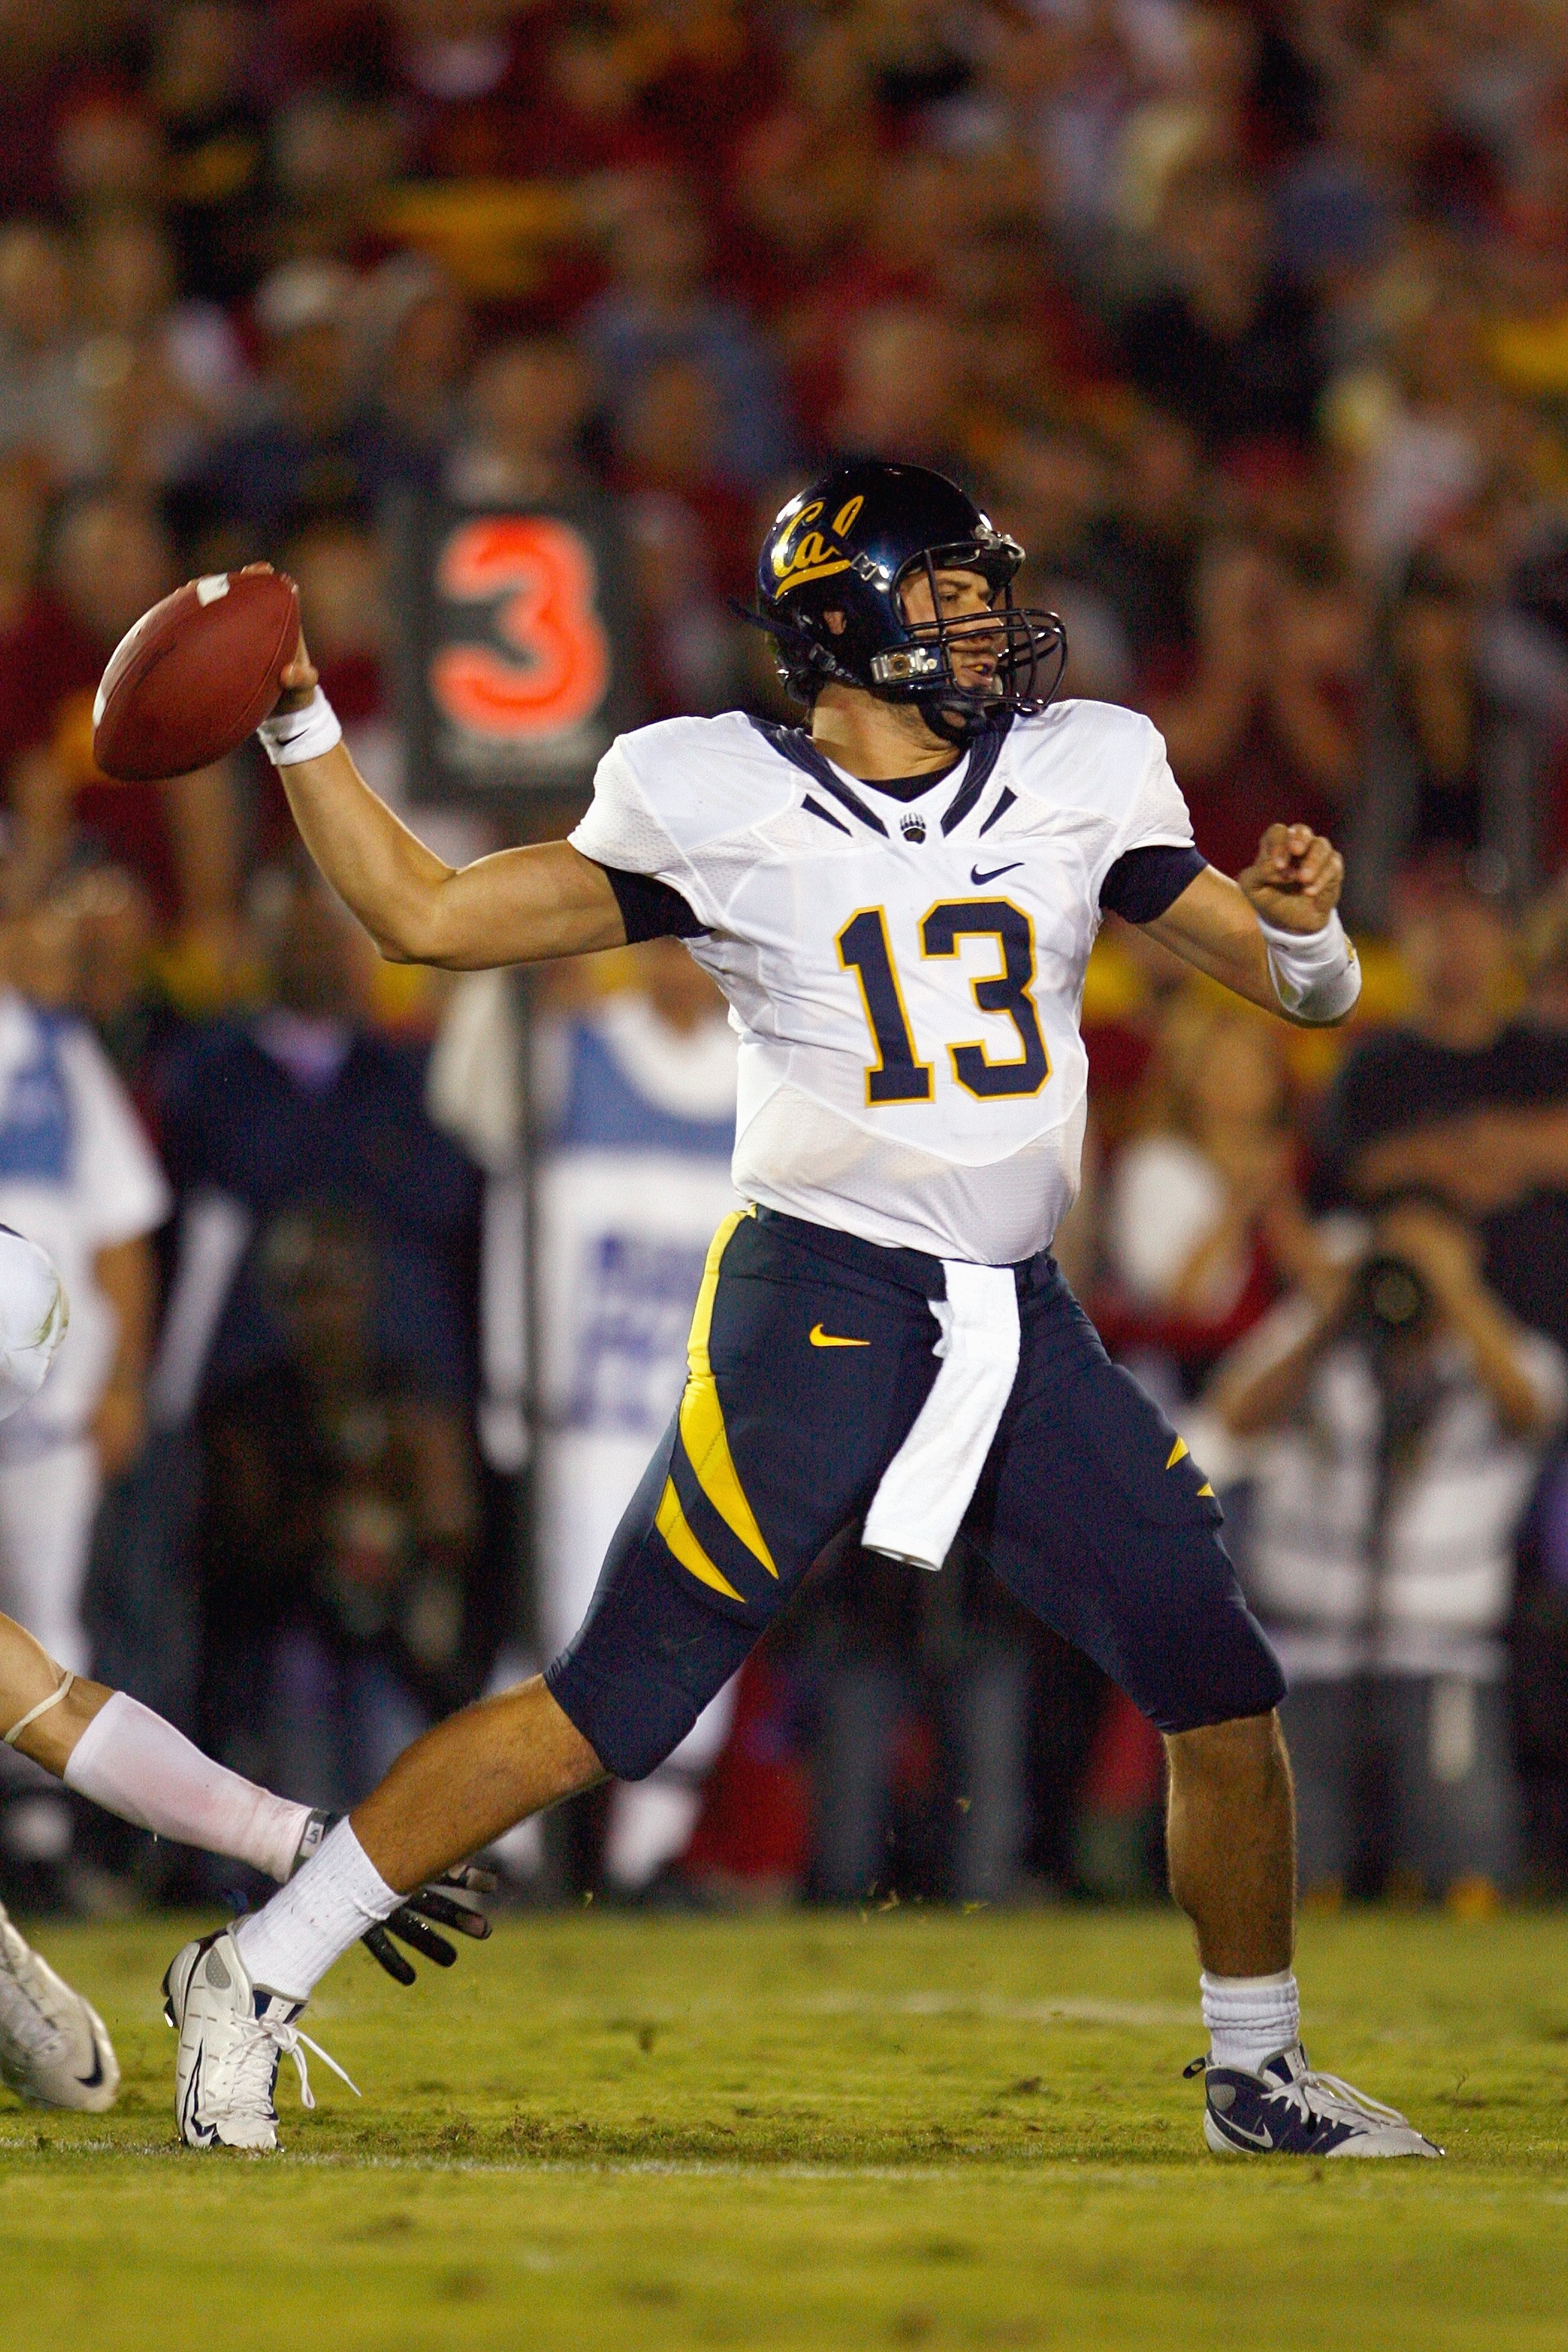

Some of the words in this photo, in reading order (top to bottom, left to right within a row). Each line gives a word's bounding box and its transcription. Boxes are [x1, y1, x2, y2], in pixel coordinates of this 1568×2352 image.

[433, 514, 609, 735] 3
[773, 495, 865, 599] Cal
[834, 896, 1052, 1108] 13
